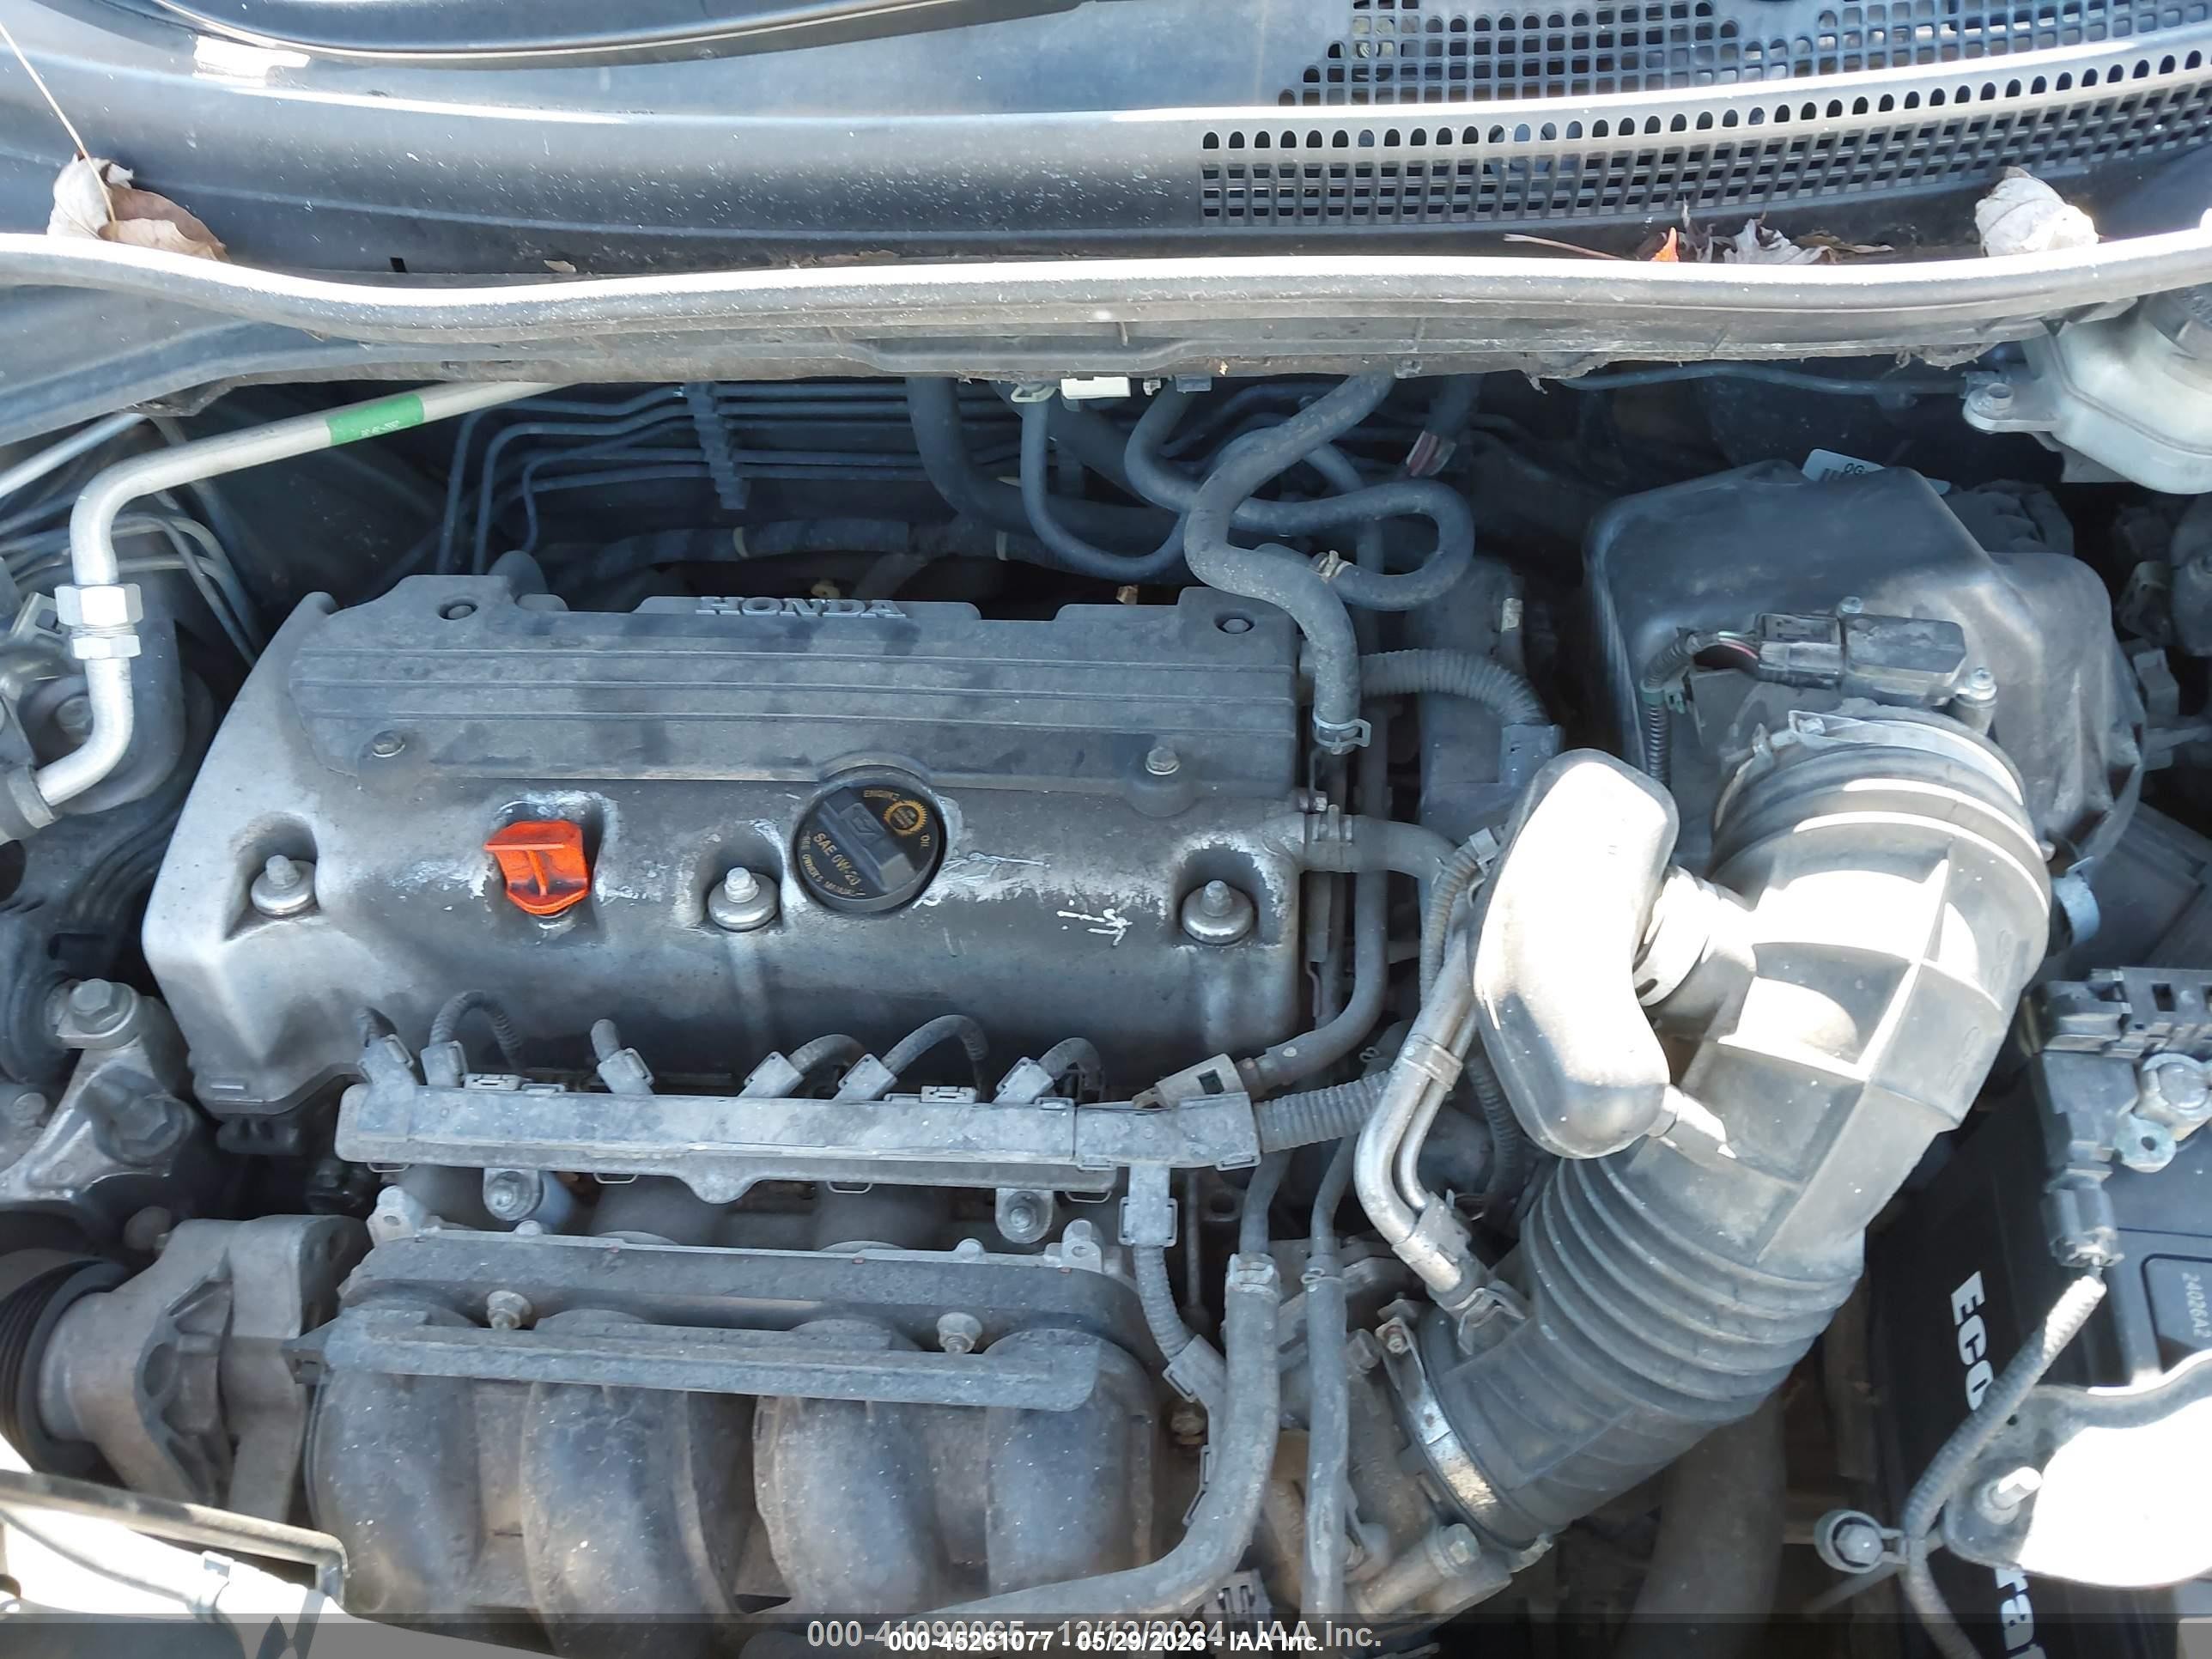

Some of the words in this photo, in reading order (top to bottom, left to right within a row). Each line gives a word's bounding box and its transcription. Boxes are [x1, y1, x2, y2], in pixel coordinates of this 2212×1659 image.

[695, 596, 907, 619] HONDA
[813, 833, 837, 856] SAE
[1950, 1270, 1994, 1412] Eco
[1994, 1567, 2047, 1659] ra
